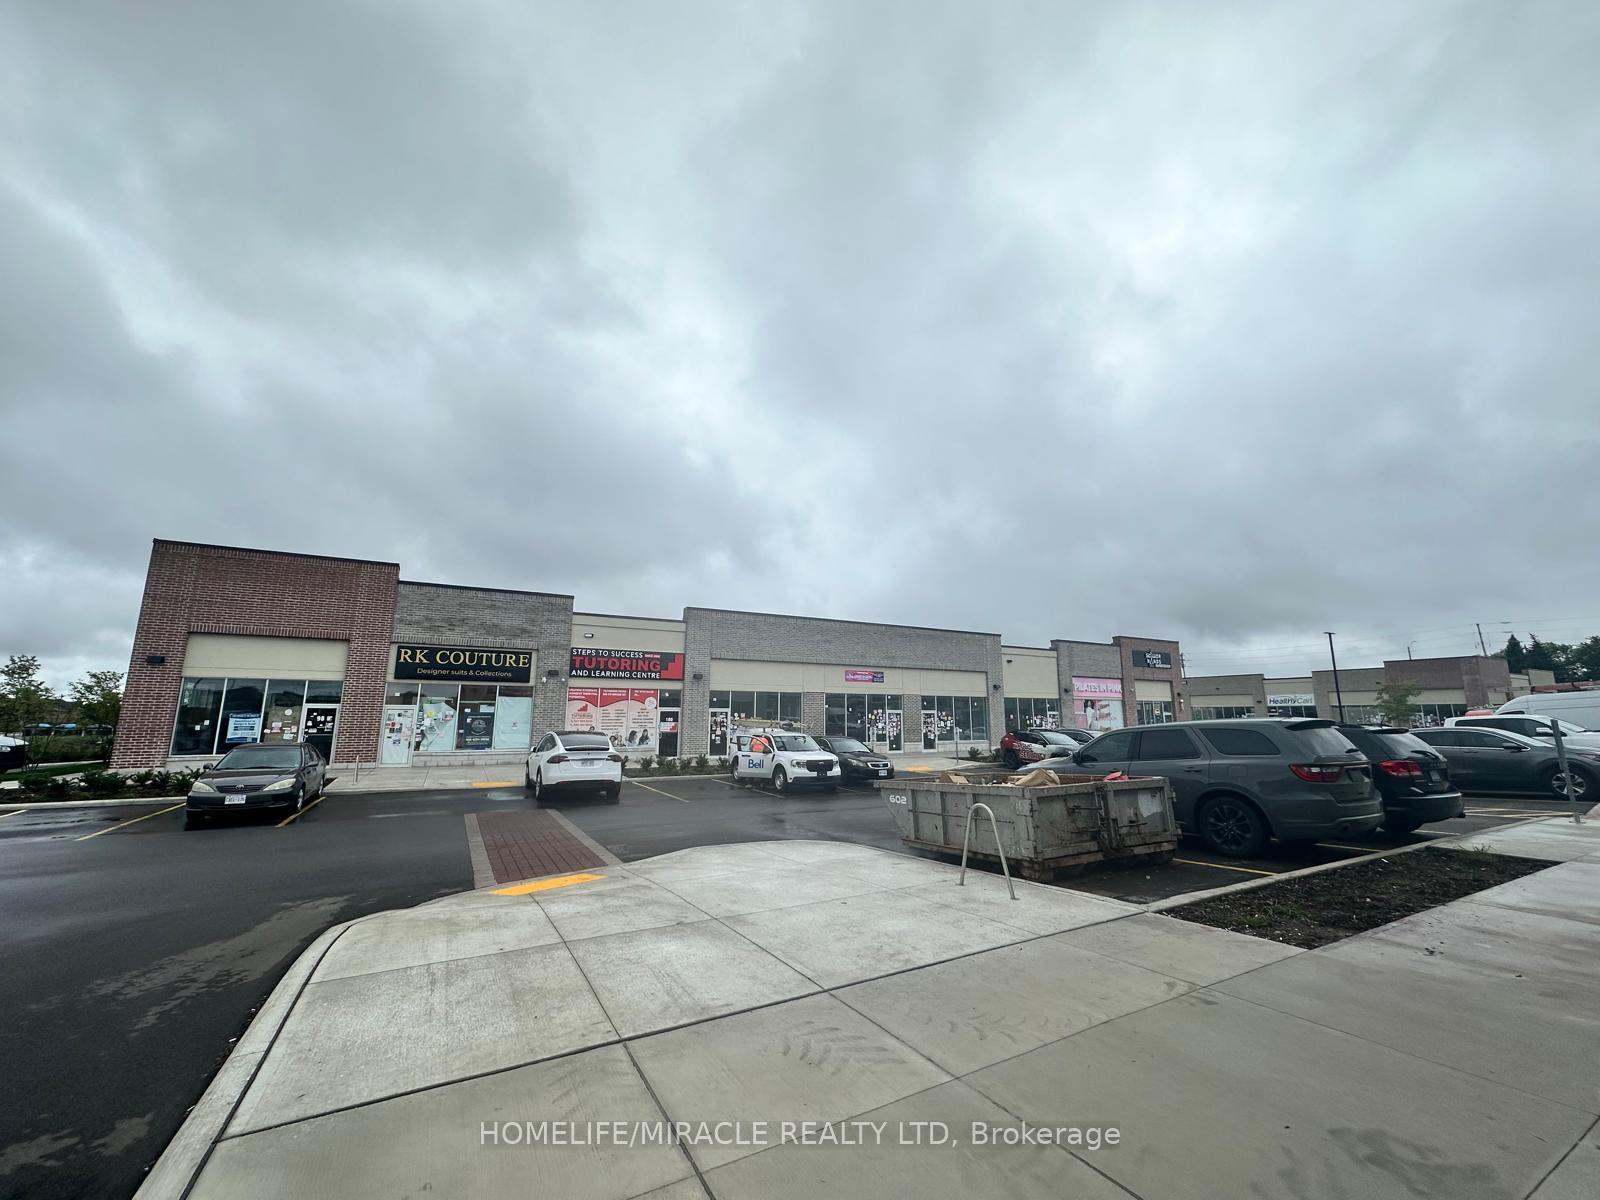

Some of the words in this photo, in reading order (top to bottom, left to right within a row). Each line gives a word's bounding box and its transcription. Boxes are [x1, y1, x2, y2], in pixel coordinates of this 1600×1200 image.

[398, 648, 430, 663] RK
[436, 650, 530, 668] COUTURE
[572, 648, 596, 656] STEPS
[599, 649, 609, 657] TO
[611, 651, 643, 659] SUCCESS
[572, 656, 660, 671] TUTORING
[417, 667, 450, 676] Designer
[475, 669, 512, 677] Collections
[571, 669, 589, 677] AND
[591, 670, 630, 678] LEARNING
[632, 671, 661, 679] CENTRE
[1074, 682, 1099, 692] PILATES
[748, 758, 764, 769] Bell
[889, 794, 907, 805] 602
